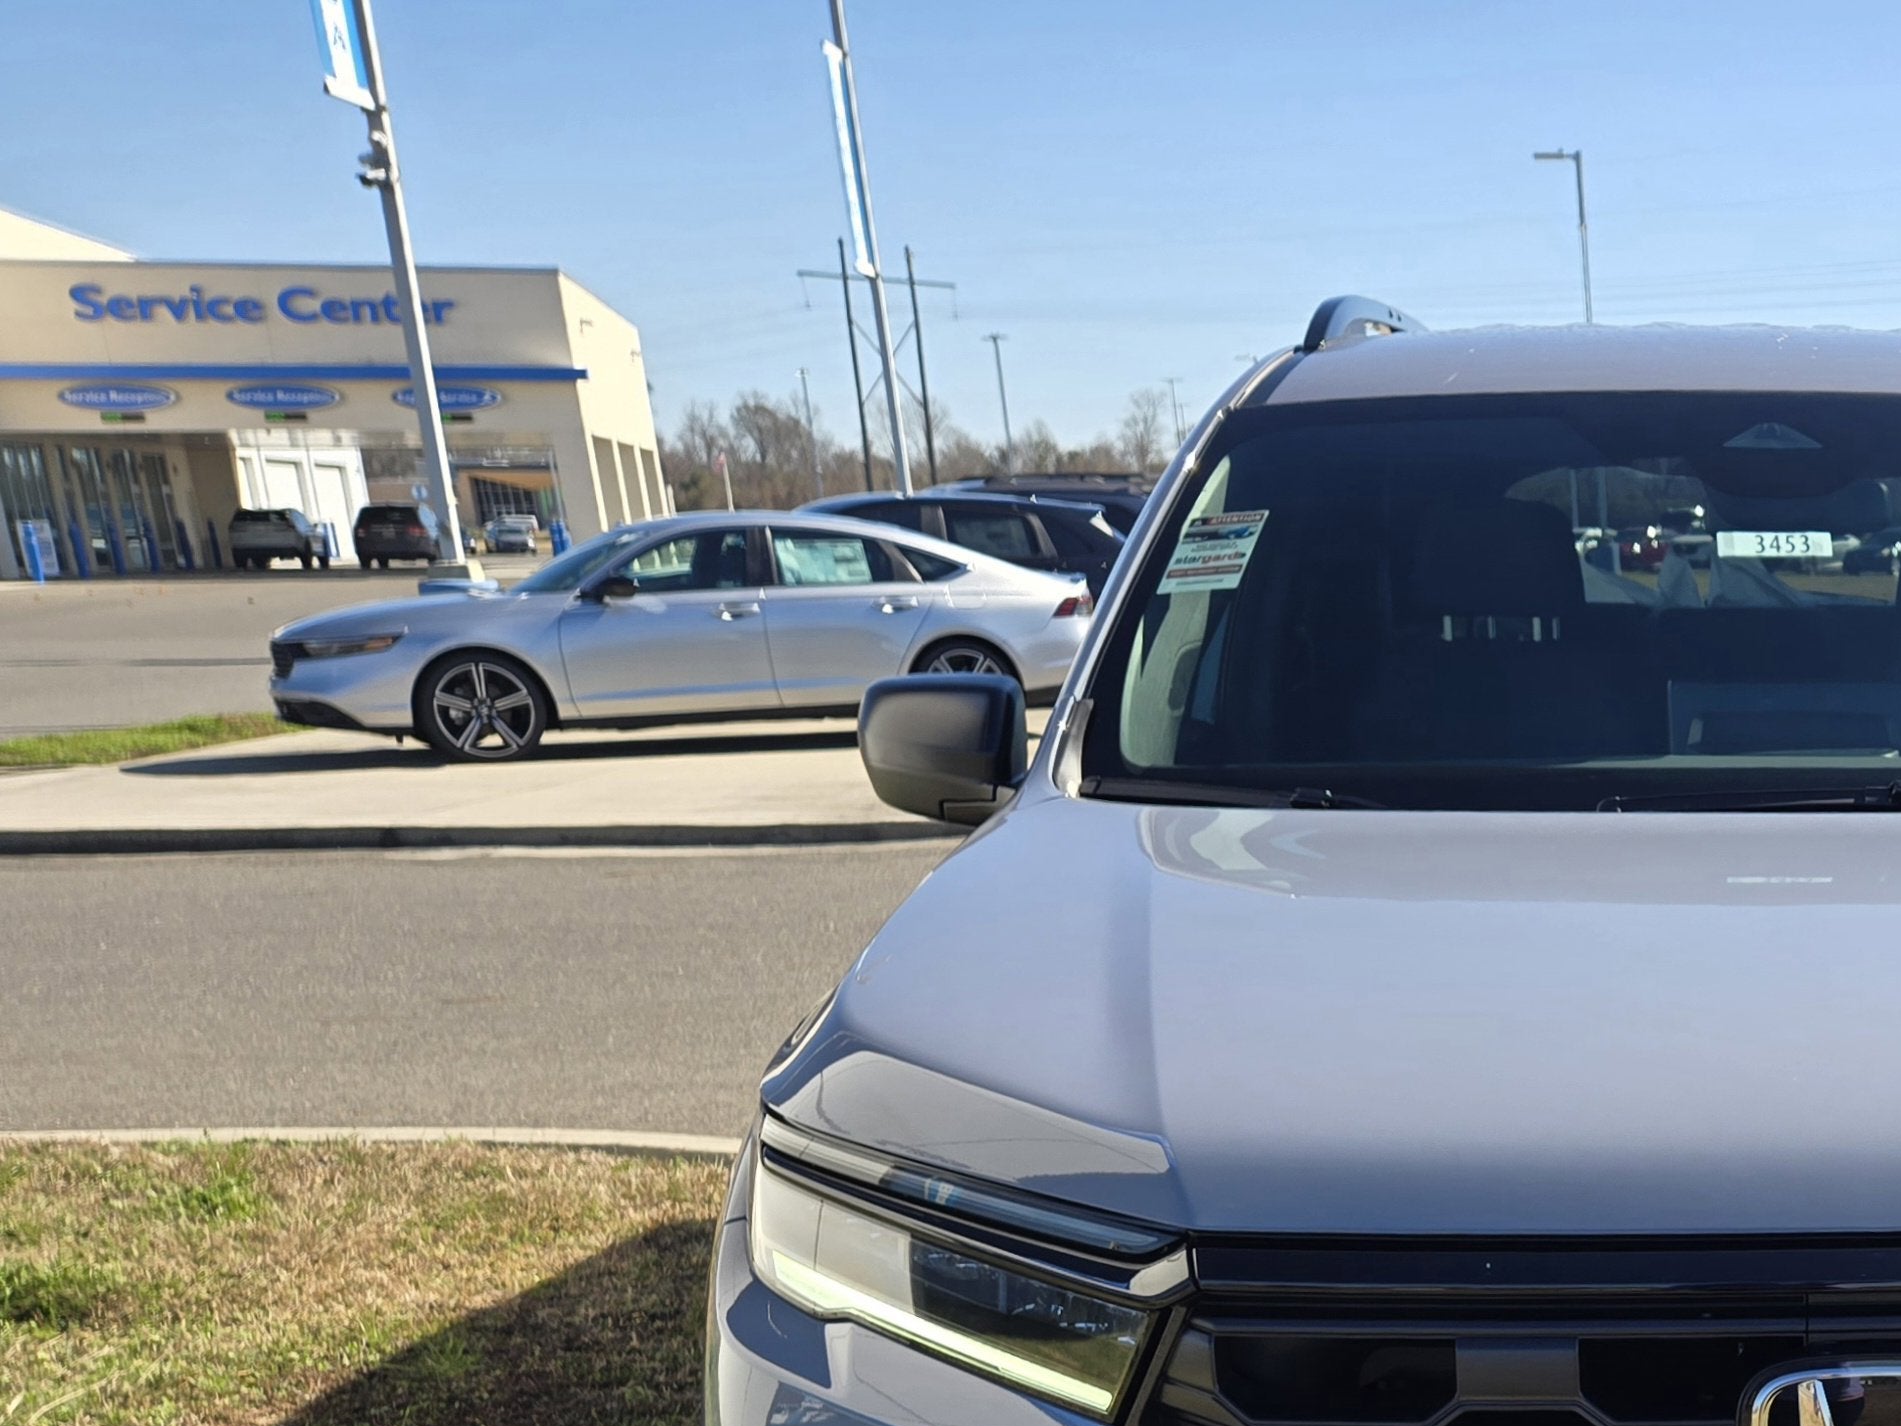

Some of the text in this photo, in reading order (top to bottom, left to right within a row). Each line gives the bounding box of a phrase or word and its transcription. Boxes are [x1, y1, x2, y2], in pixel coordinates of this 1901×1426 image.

[69, 284, 456, 325] Service Centr
[1755, 534, 1810, 553] 3453
